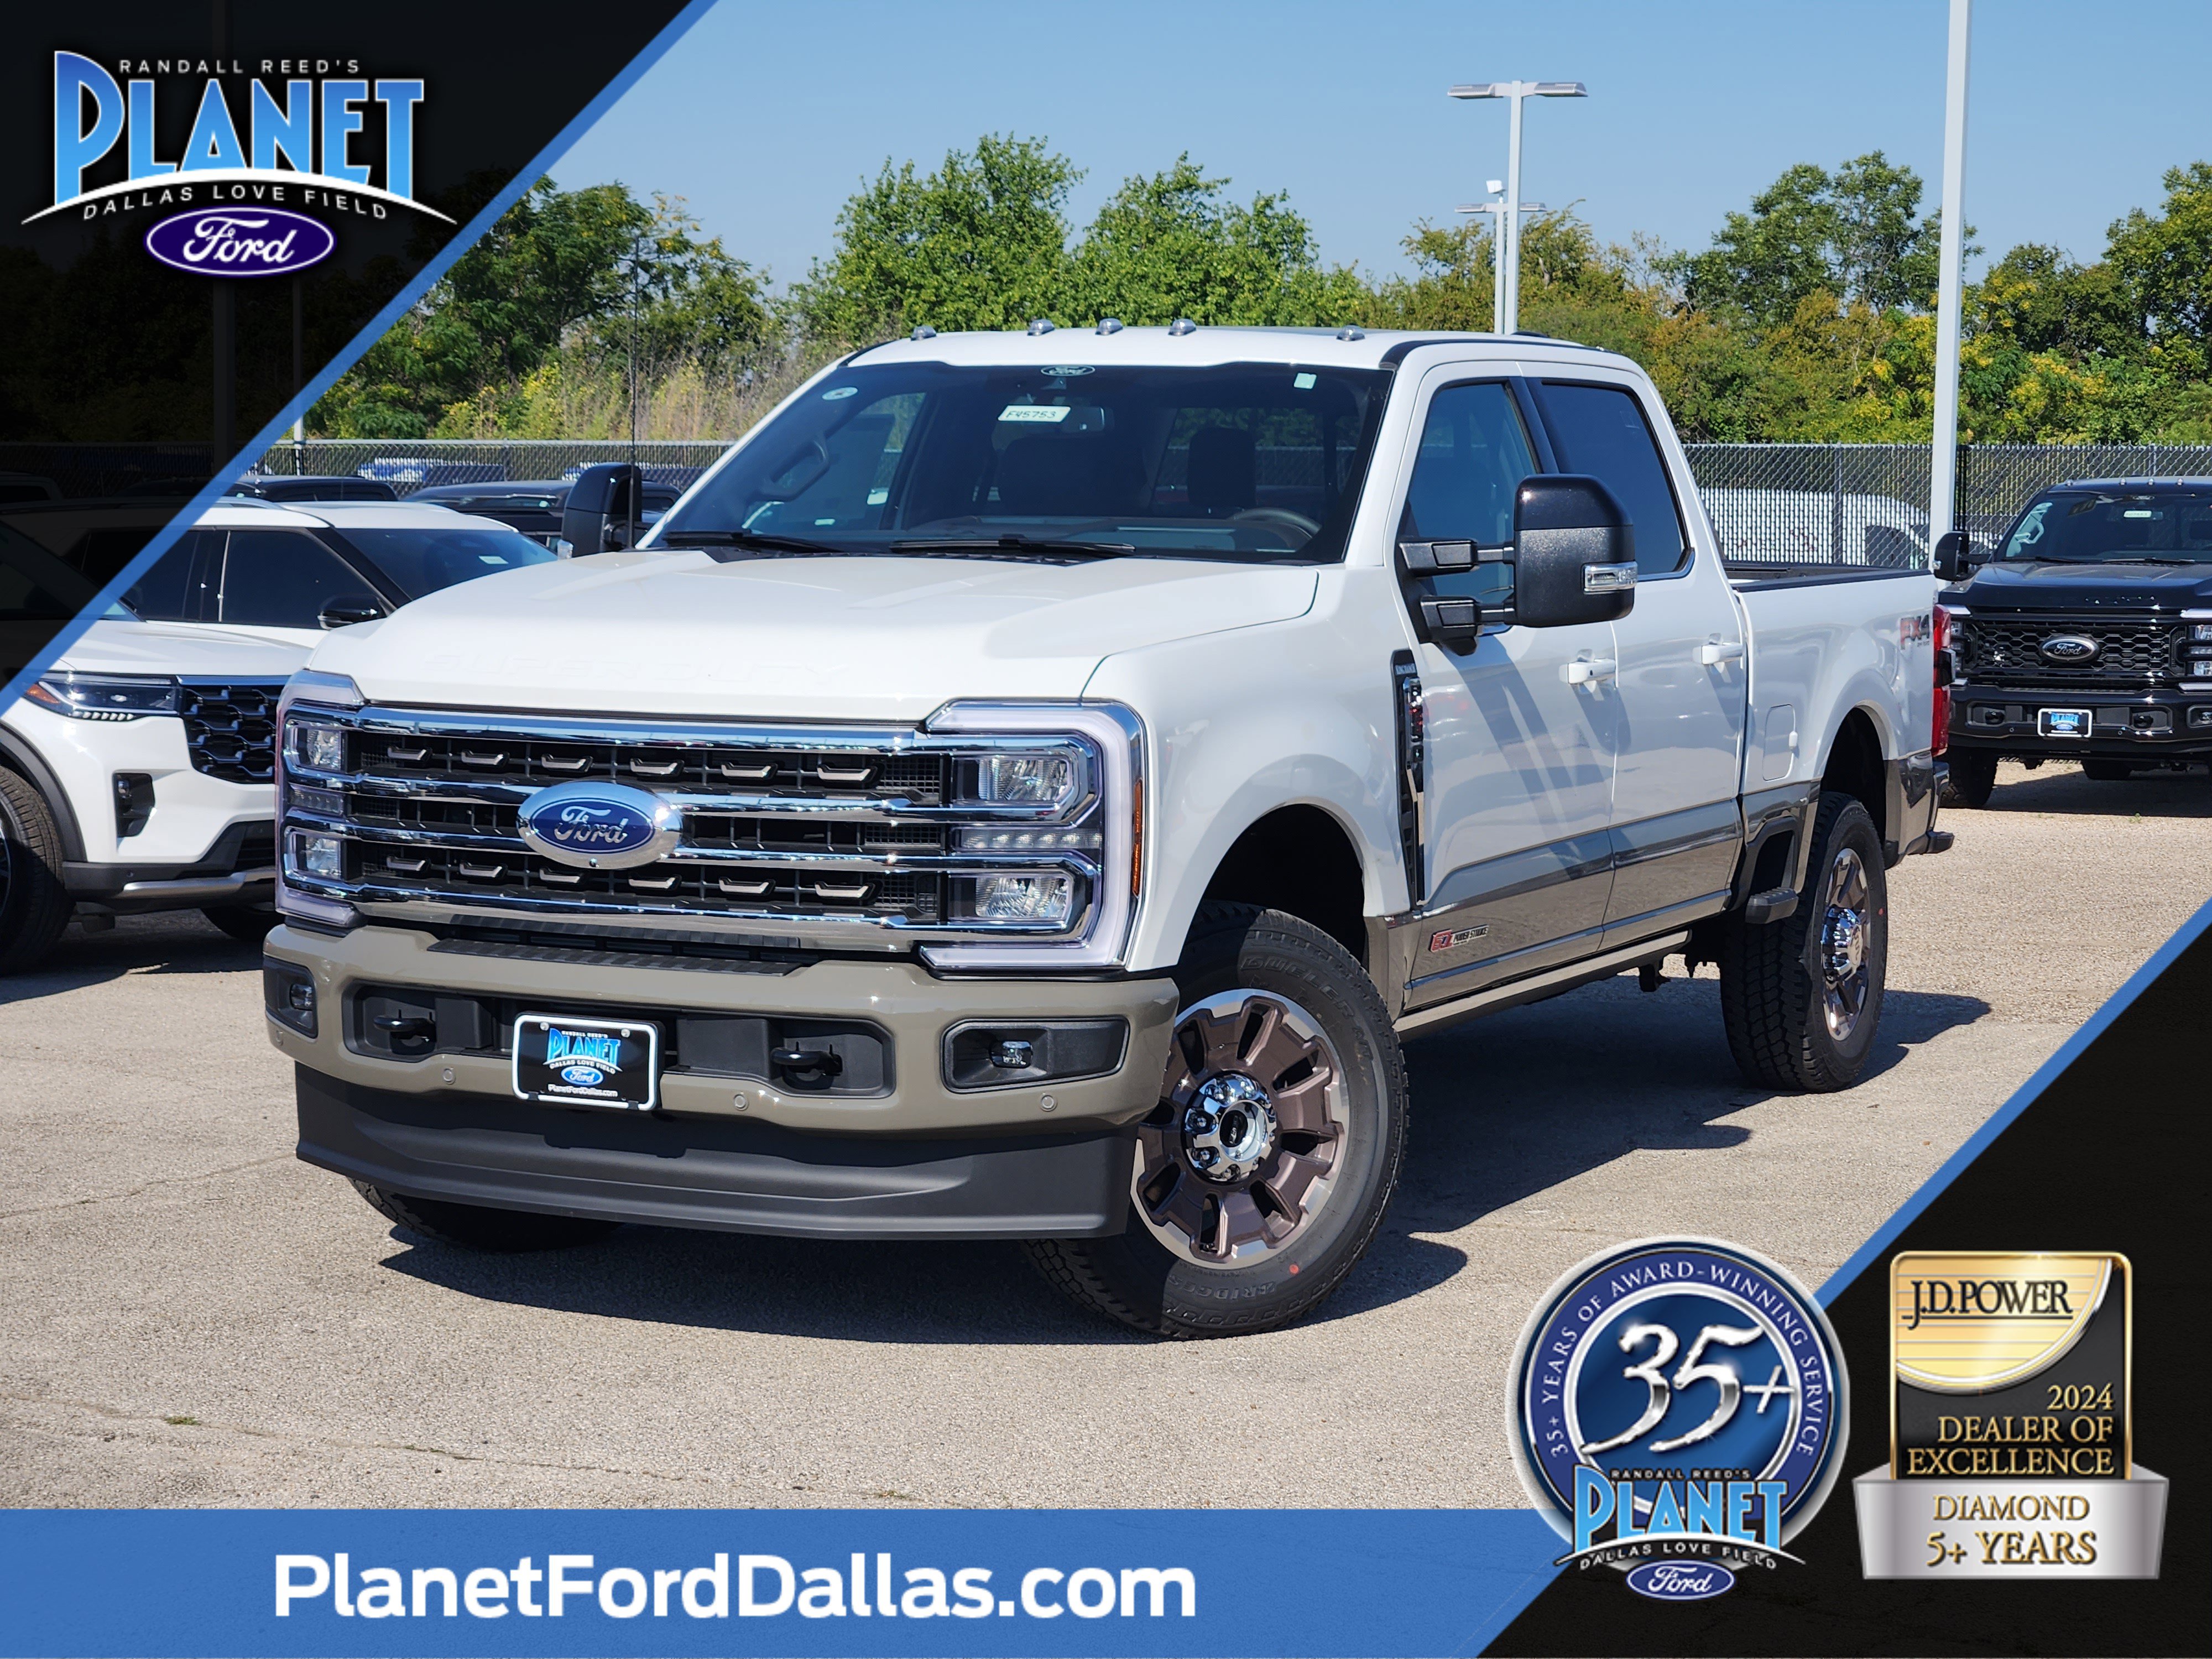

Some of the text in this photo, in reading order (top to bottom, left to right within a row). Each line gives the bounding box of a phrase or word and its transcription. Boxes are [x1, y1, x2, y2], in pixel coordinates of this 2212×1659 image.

[1900, 614, 1930, 650] FX4
[2054, 643, 2083, 655] Ford
[554, 806, 629, 844] Ford
[547, 1027, 621, 1066] PLANET
[570, 1068, 595, 1083] Ford
